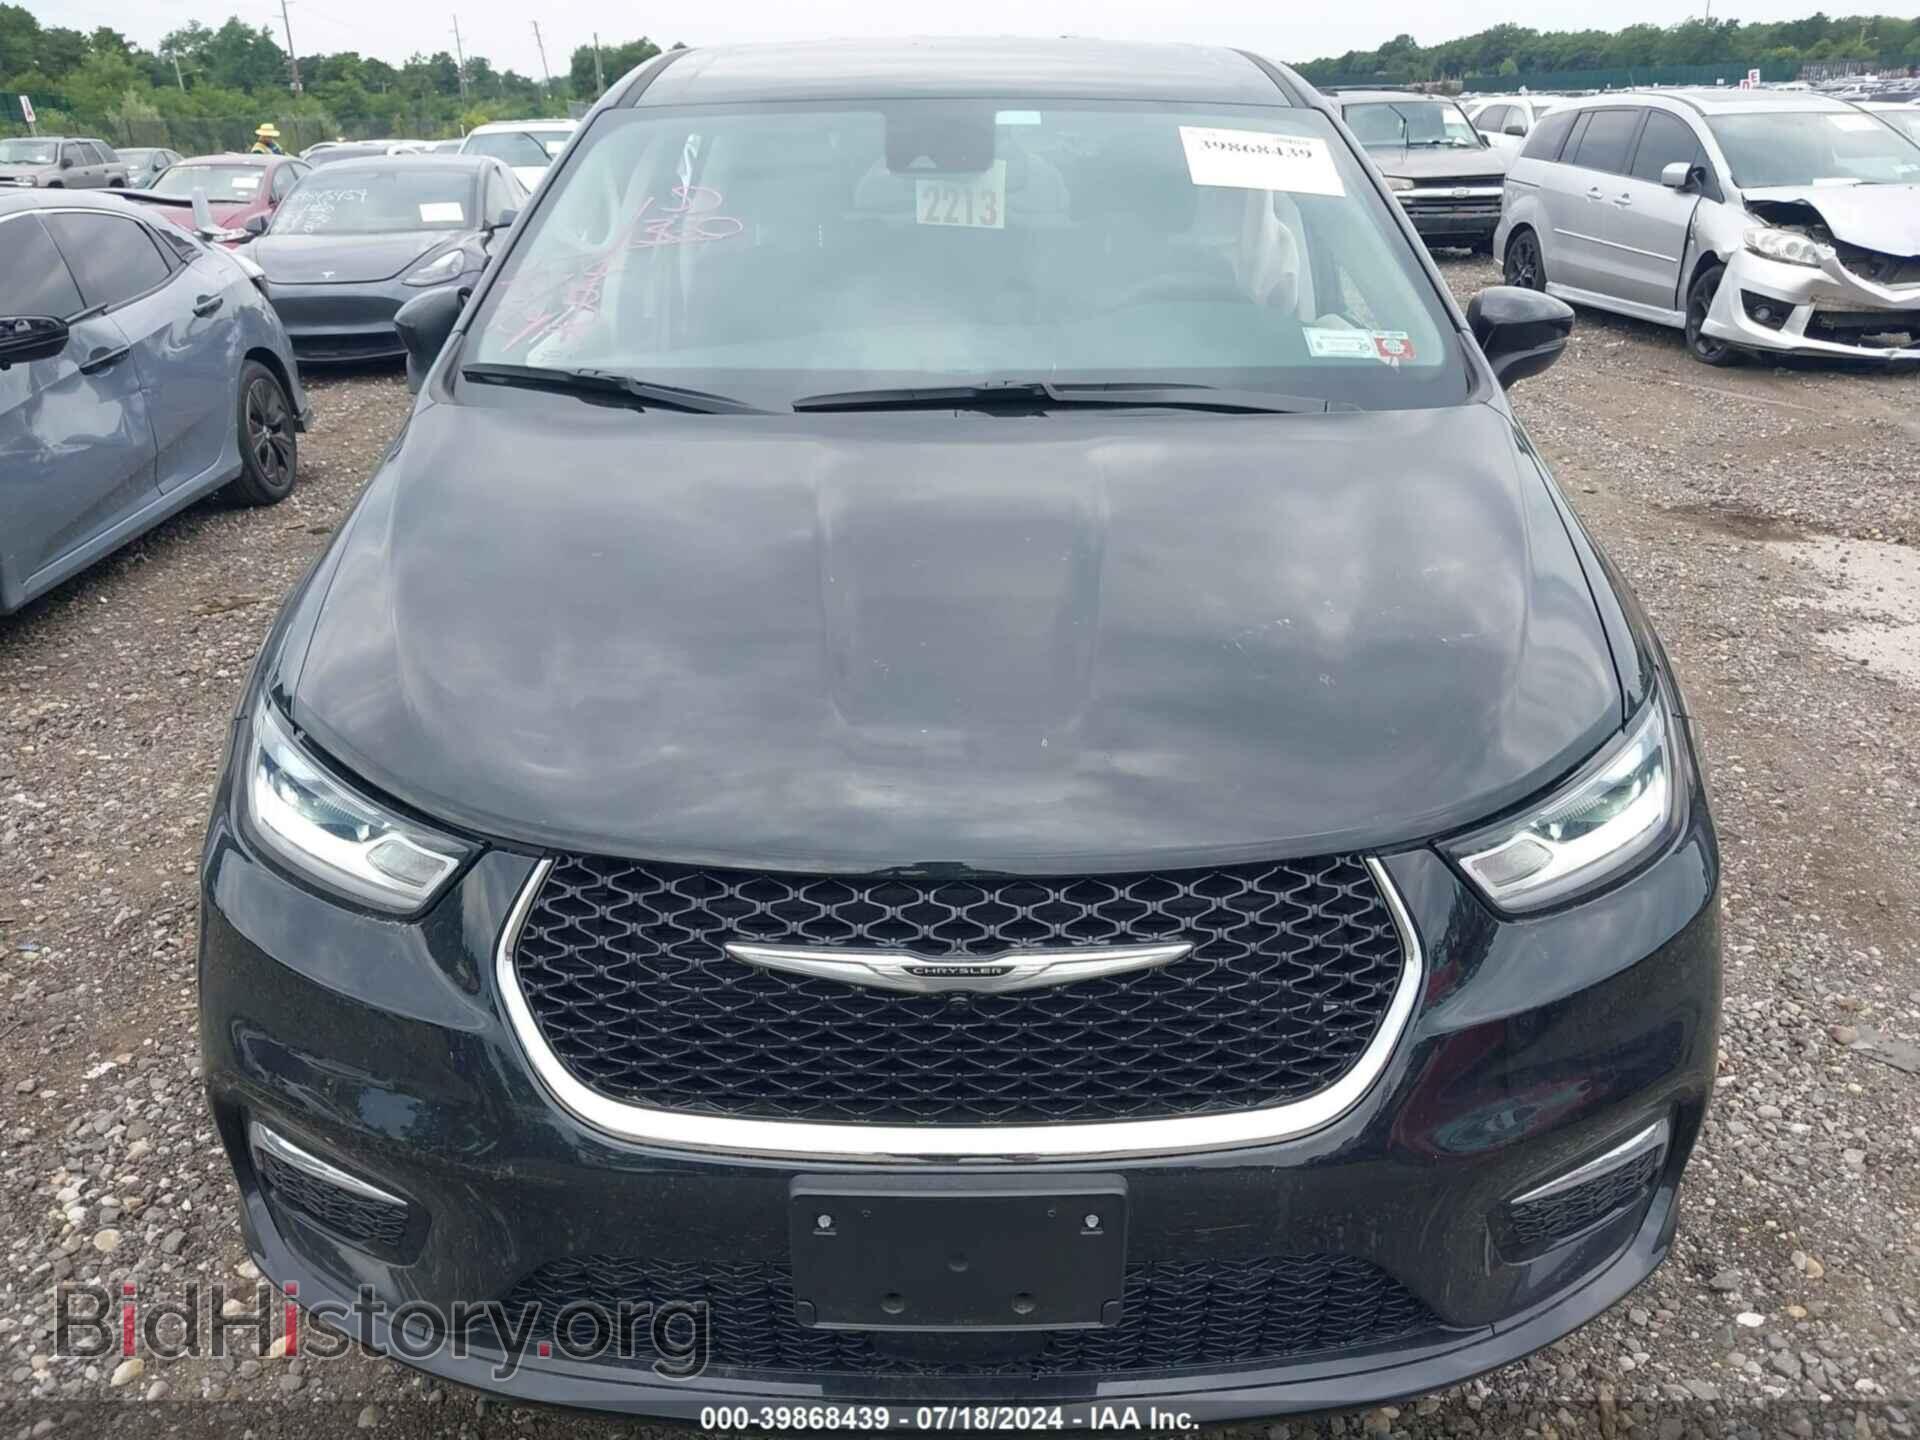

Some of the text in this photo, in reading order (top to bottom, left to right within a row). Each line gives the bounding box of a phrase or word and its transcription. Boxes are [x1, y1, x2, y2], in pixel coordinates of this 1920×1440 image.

[1202, 139, 1312, 158] 39868439
[920, 187, 997, 225] 2213
[912, 967, 1002, 975] CHRYSLER
